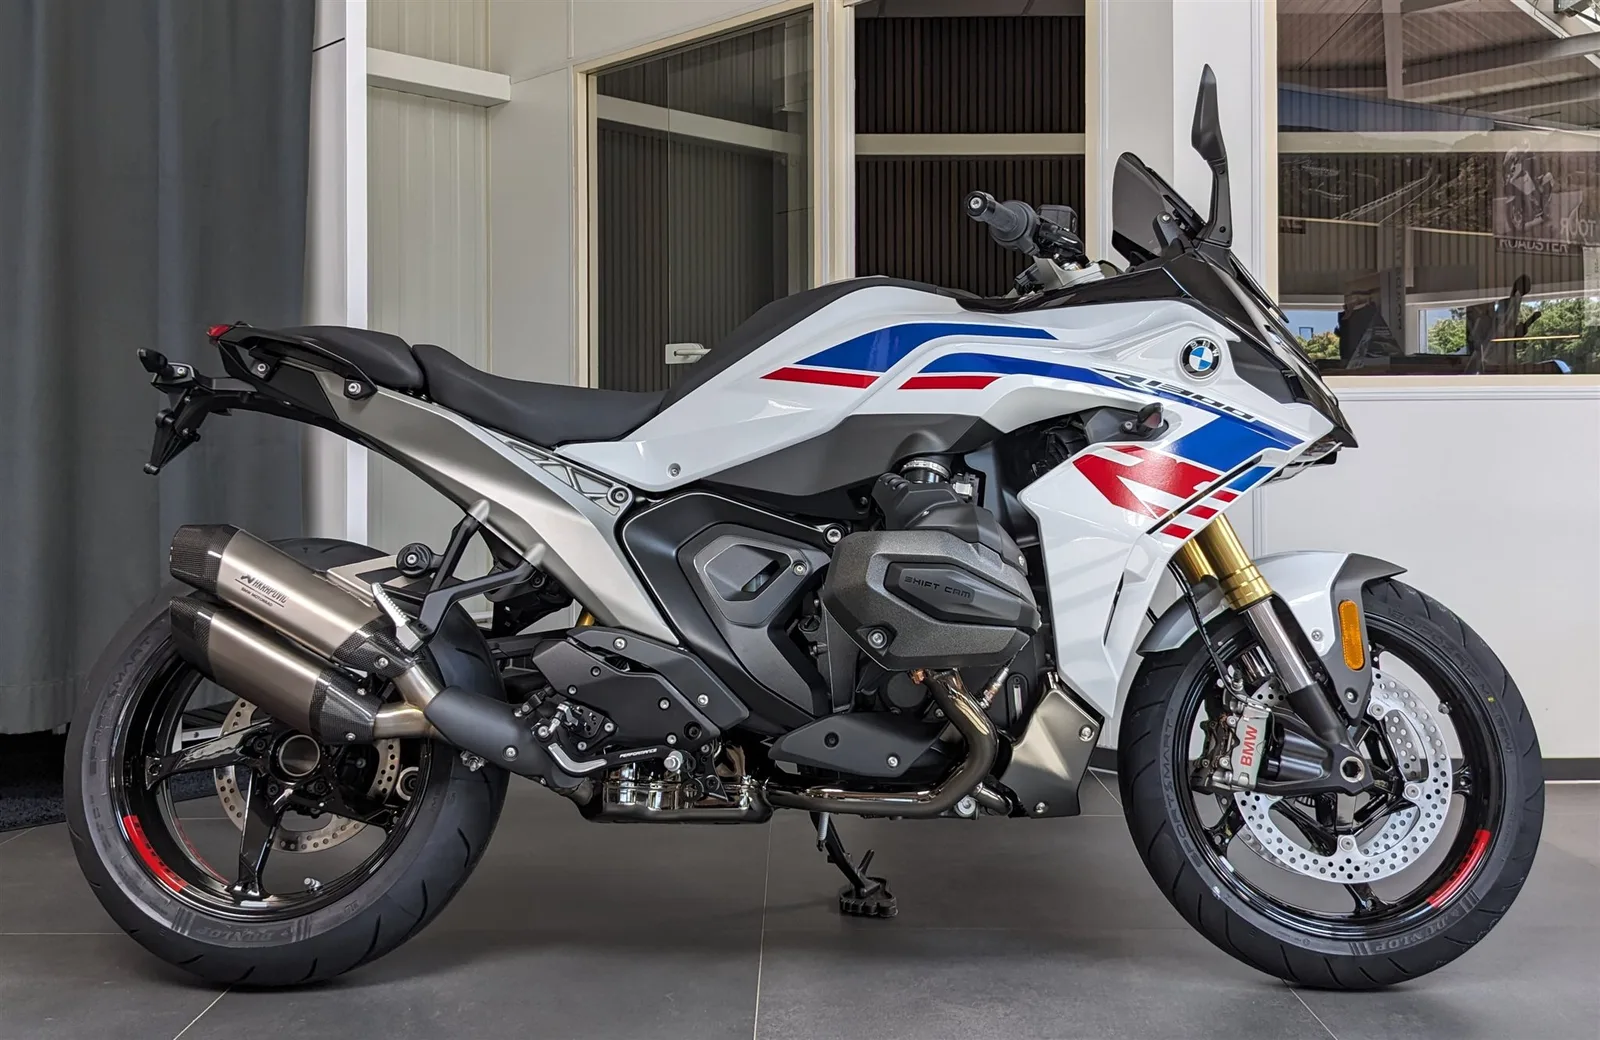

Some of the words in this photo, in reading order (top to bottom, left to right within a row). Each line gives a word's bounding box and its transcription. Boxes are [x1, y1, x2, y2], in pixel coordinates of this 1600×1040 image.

[1189, 339, 1220, 357] BMW
[903, 575, 940, 590] SHIFT
[944, 586, 971, 599] CAM
[1240, 725, 1257, 767] BMW
[1375, 916, 1449, 951] DUNLOP
